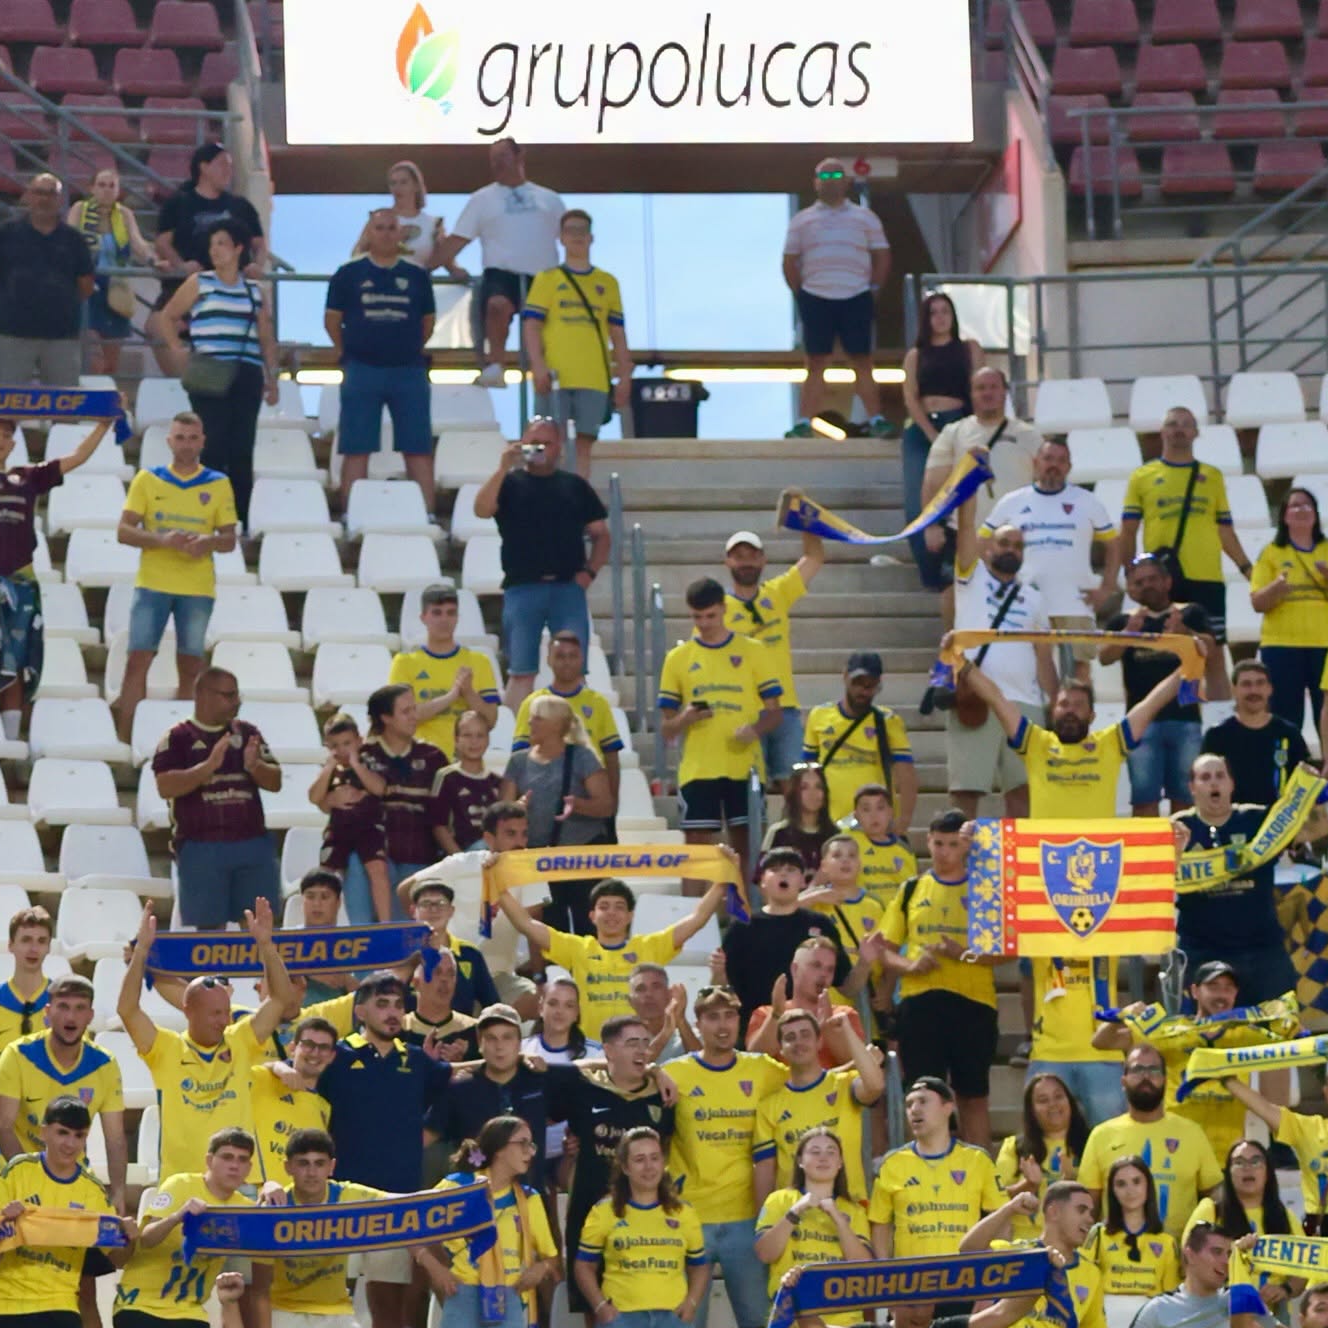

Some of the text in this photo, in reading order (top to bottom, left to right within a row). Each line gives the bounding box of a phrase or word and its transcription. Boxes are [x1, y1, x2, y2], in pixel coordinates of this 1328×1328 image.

[477, 13, 870, 134] grupolucas
[54, 394, 86, 410] CF
[1252, 786, 1308, 857] ESKORPION
[536, 854, 652, 873] ORIHUELA
[192, 938, 371, 965] ORIHELA CF
[1227, 1046, 1300, 1063] FRENTE
[274, 1201, 465, 1243] ORIHUELA CF
[824, 1262, 1024, 1300] ORIHUELA CF
